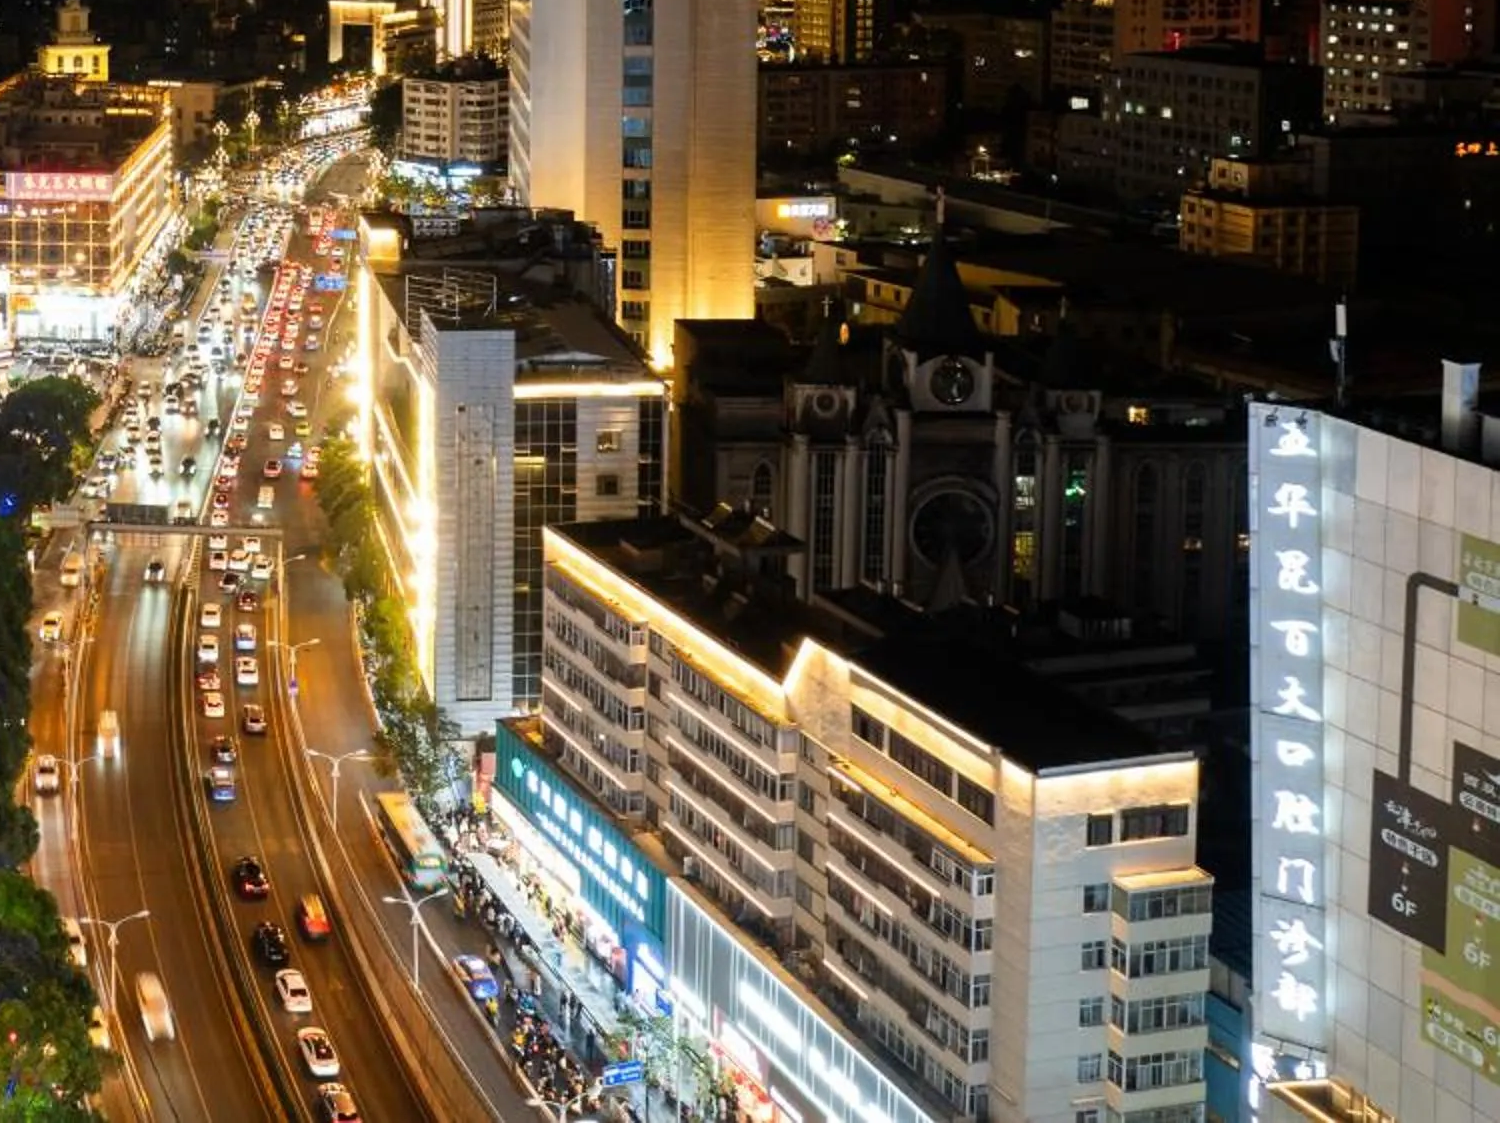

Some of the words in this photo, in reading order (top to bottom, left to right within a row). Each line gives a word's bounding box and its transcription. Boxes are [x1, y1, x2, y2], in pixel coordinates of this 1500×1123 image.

[1267, 422, 1323, 1023] 五华昆百大口腔门诊部
[1391, 892, 1418, 918] 6F
[1463, 941, 1491, 969] 6F
